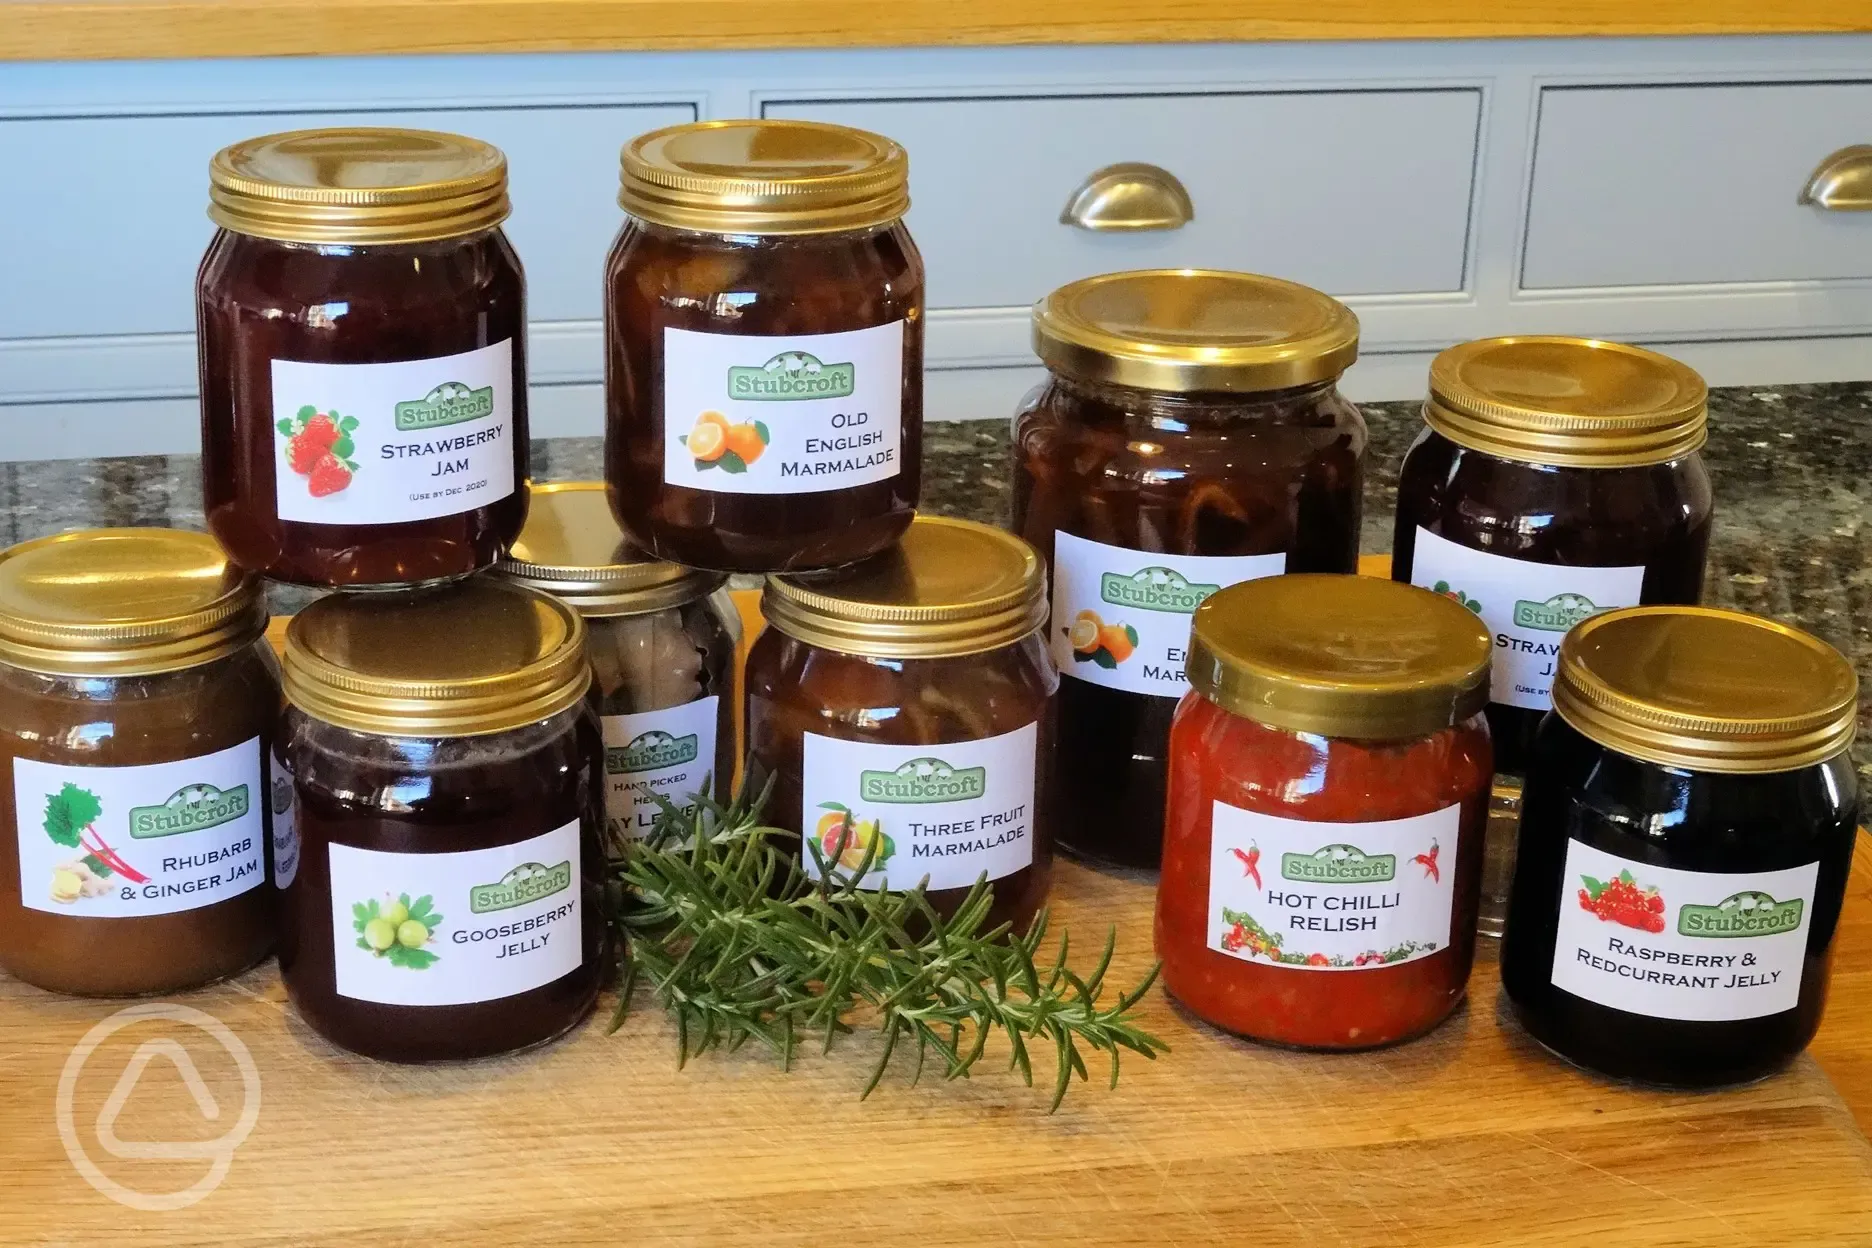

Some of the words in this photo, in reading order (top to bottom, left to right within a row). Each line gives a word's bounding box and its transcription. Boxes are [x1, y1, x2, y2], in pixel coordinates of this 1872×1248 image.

[736, 371, 848, 394] Stubcroft
[402, 394, 489, 424] Stubcroft
[831, 412, 868, 428] OLD
[381, 424, 504, 459] STRAWBERRY
[805, 430, 883, 453] ENGLISH
[431, 458, 469, 477] JAM
[781, 449, 894, 477] MARMALADE
[1521, 607, 1582, 629] Stubc
[607, 743, 693, 769] Stubcroft
[650, 773, 687, 787] PICKED
[868, 776, 978, 797] Stubcroft
[137, 794, 243, 833] Stubcroft
[909, 819, 975, 837] THREE
[981, 805, 1026, 830] FRUIT
[912, 825, 1026, 858] MARMALADE
[162, 838, 252, 873] RHUBARB
[1288, 860, 1389, 878] Stubcroft
[120, 887, 136, 901] &
[143, 874, 221, 899] GINGER
[225, 859, 258, 883] JAM
[477, 868, 566, 908] Stubcroft
[1268, 890, 1317, 910] HOT
[1323, 892, 1401, 911] CHILLI
[452, 900, 576, 944] GOOSEBERRY
[1290, 915, 1377, 931] RELISH
[1687, 908, 1797, 931] Stubcroft
[496, 932, 551, 959] JELLY
[1608, 937, 1737, 968] RASPBERRY
[1741, 953, 1757, 966] &
[1576, 948, 1719, 989] REDCURRANT
[1724, 971, 1781, 988] JELLY
